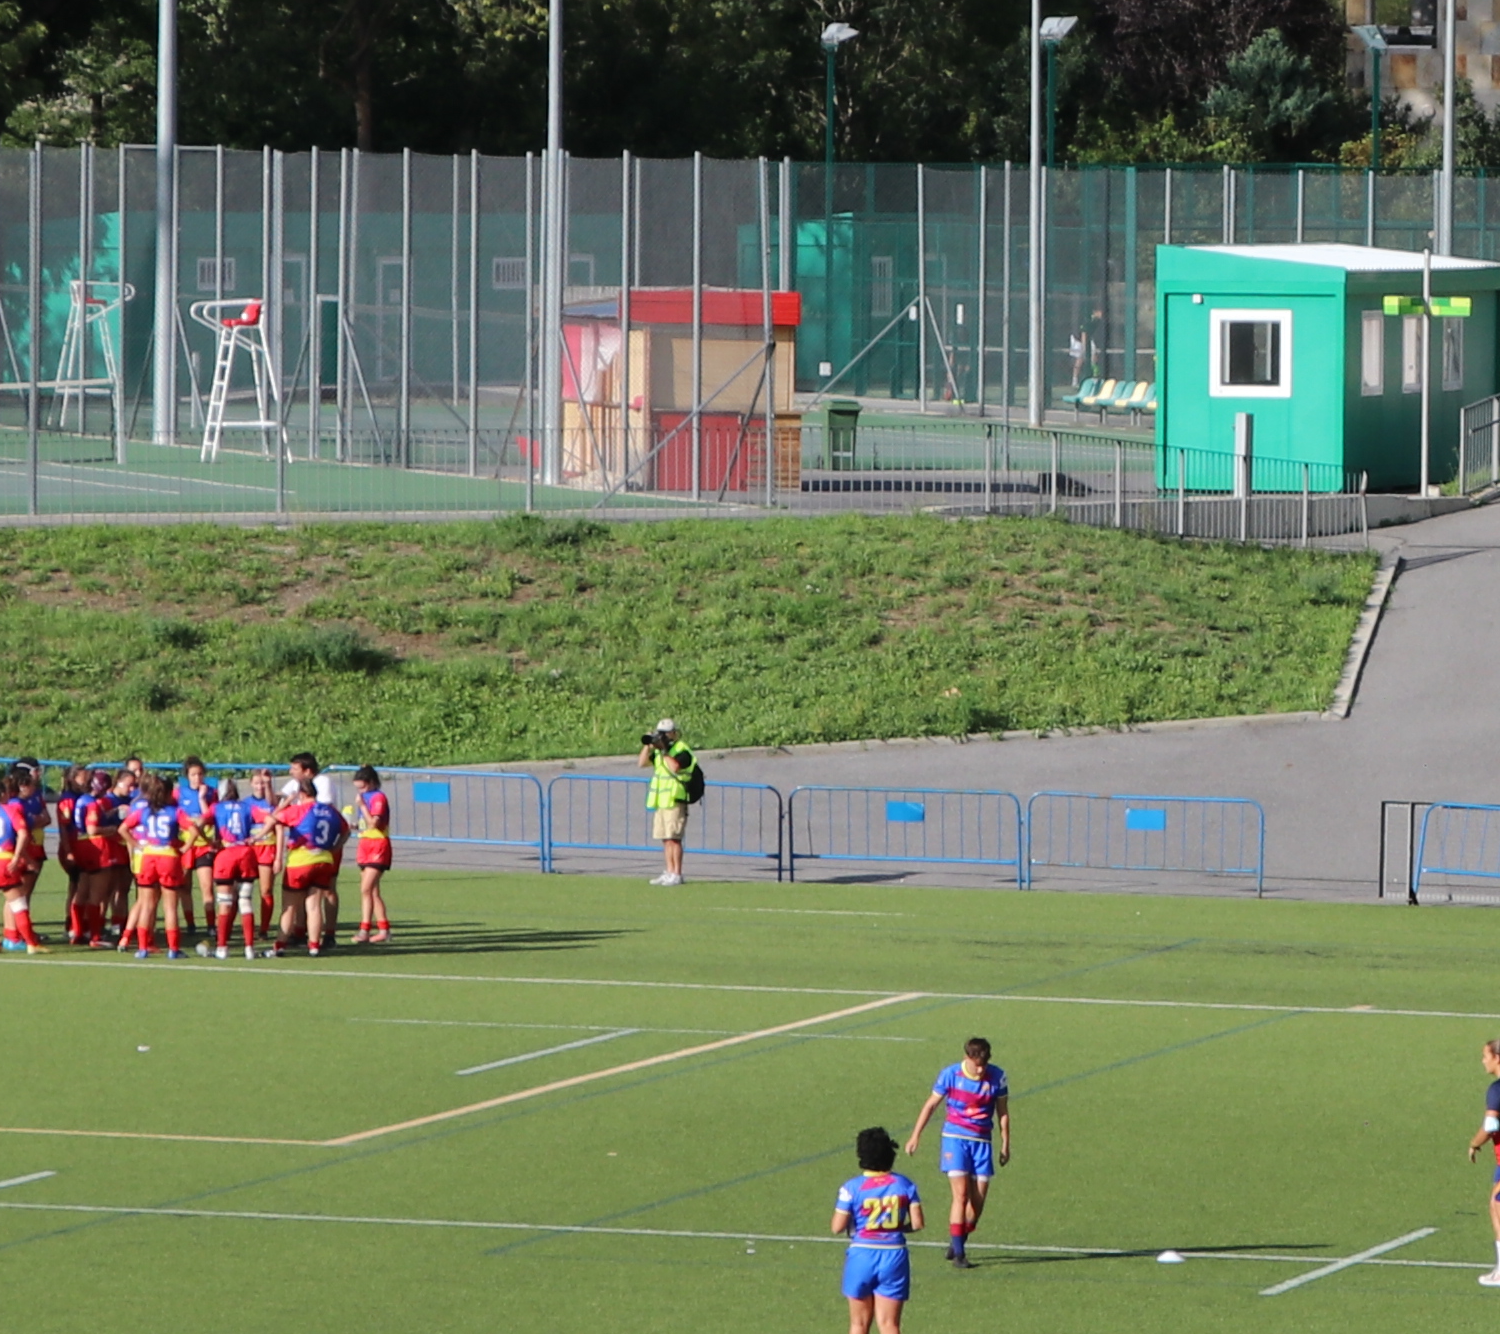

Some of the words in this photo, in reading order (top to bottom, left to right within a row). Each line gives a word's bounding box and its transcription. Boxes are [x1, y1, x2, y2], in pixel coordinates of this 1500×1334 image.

[147, 815, 171, 838] 15
[314, 819, 330, 845] 3
[863, 1195, 899, 1230] 23
